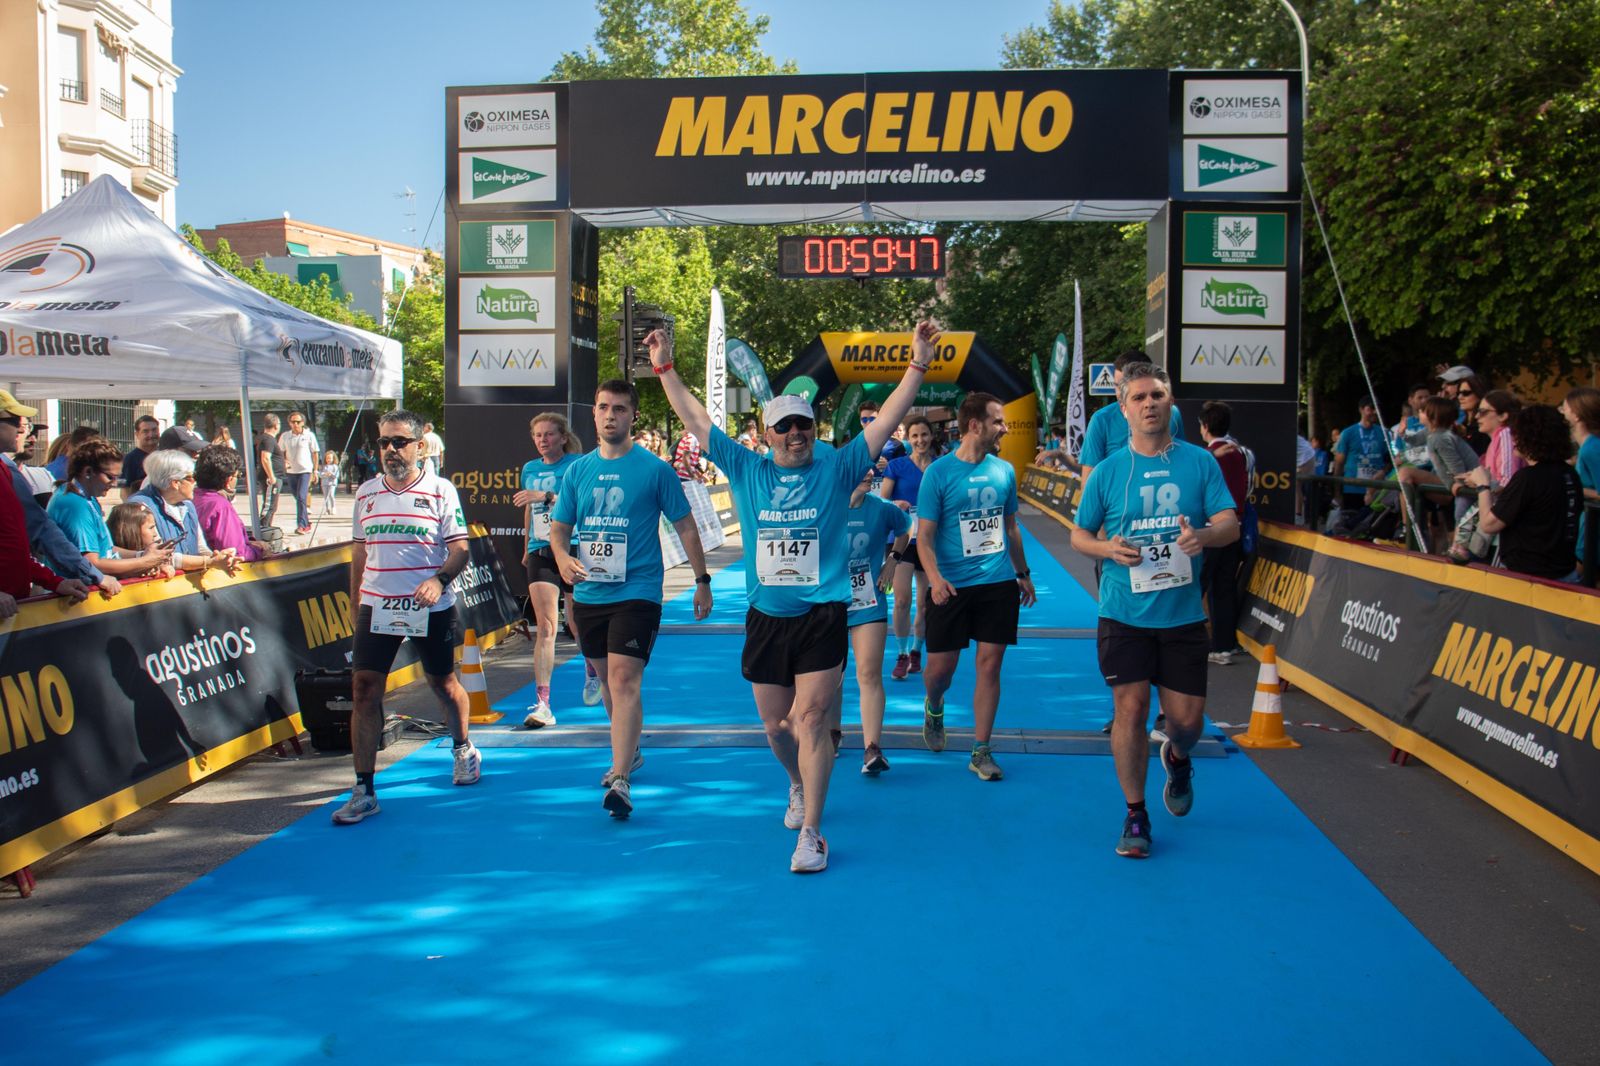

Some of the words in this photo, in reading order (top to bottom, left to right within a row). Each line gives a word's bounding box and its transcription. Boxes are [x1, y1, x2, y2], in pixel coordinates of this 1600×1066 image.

[1213, 97, 1281, 108] OXIMESA
[487, 109, 550, 122] OXIMESA
[655, 90, 1073, 157] MARCELINO
[1213, 111, 1248, 119] NIPPON
[1252, 110, 1281, 118] GASES
[487, 124, 519, 132] NIPPON
[522, 122, 550, 131] GASES
[746, 163, 987, 190] www.mpmarcelino.es
[804, 238, 939, 274] 00:59:47
[477, 296, 540, 313] Natura
[1201, 290, 1268, 308] Natura
[468, 349, 548, 369] ANAYA
[1190, 345, 1276, 366] ANAYA
[1139, 482, 1181, 516] 18
[758, 508, 818, 522] MARCELINO
[365, 522, 429, 536] COVIRAN
[969, 516, 999, 533] 2040
[590, 543, 613, 557] 828
[767, 541, 811, 557] 1147
[1149, 544, 1171, 562] 34
[1341, 599, 1401, 642] agustinos
[1341, 633, 1380, 663] GRANADA
[146, 626, 256, 689] agustinos
[176, 669, 246, 707] GRANADA
[1456, 704, 1559, 769] www.mpmarcelino.es
